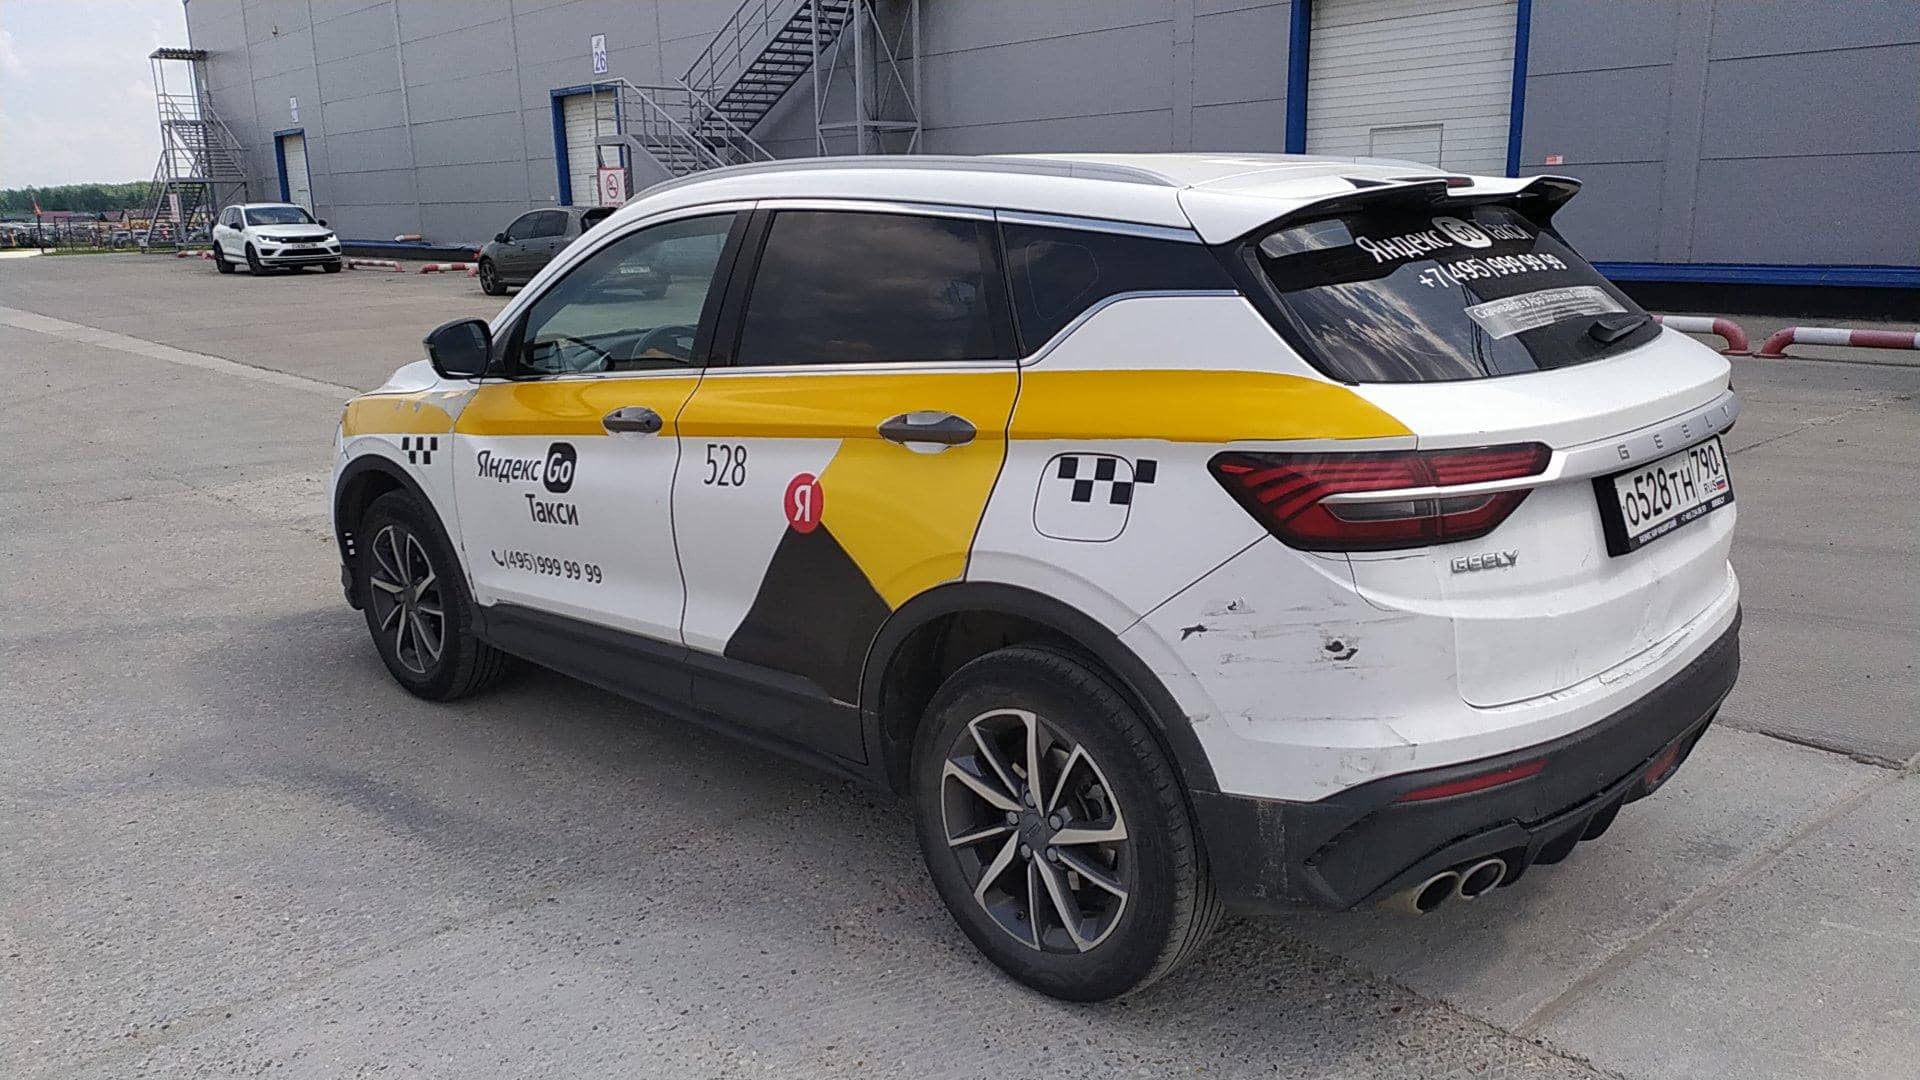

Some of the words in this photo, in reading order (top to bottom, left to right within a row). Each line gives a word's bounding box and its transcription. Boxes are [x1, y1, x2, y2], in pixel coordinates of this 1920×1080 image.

[594, 51, 606, 72] 26
[1355, 229, 1453, 263] Яндекс
[1467, 219, 1535, 240] Такси
[1617, 402, 1729, 460] GEELY
[477, 450, 541, 483] Яндекс
[703, 444, 747, 487] 528
[1691, 445, 1719, 482] 790
[794, 484, 812, 522] Я
[1704, 480, 1717, 494] RUS
[525, 493, 579, 526] Такси
[564, 560, 581, 580] 99
[584, 564, 603, 584] 99
[1451, 549, 1519, 574] GEELY
